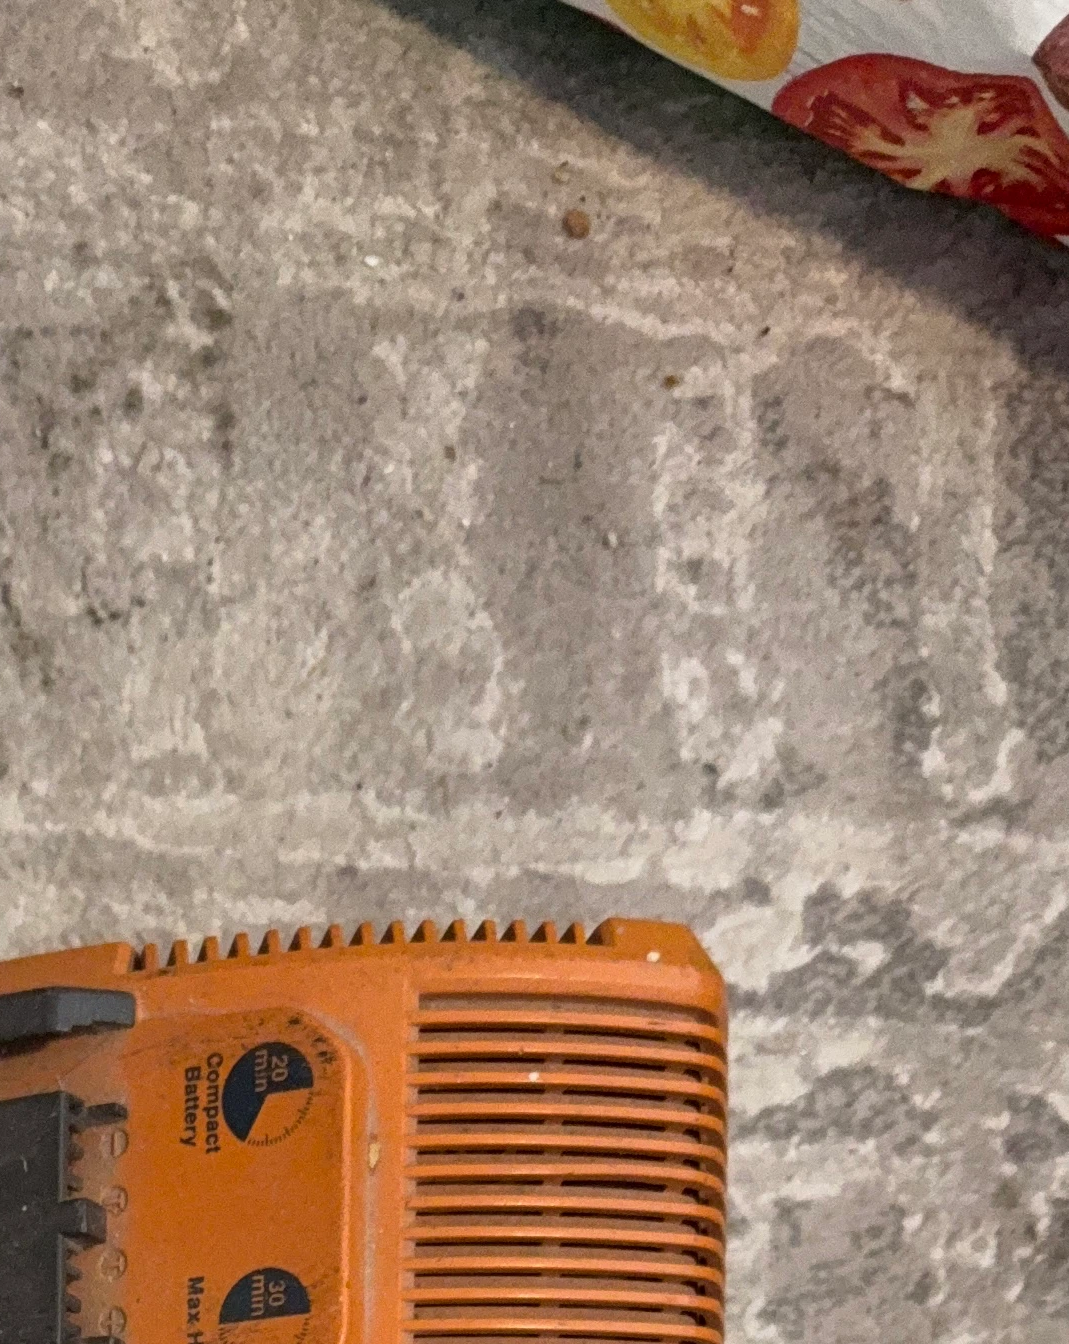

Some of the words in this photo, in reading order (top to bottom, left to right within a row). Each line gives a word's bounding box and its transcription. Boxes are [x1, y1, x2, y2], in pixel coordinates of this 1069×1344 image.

[253, 1050, 269, 1092] min
[271, 1056, 288, 1082] 20
[180, 1066, 202, 1146] Battery
[203, 1052, 223, 1154] Compact
[187, 1276, 205, 1324] Max
[251, 1276, 267, 1316] min
[268, 1281, 285, 1306] 30
